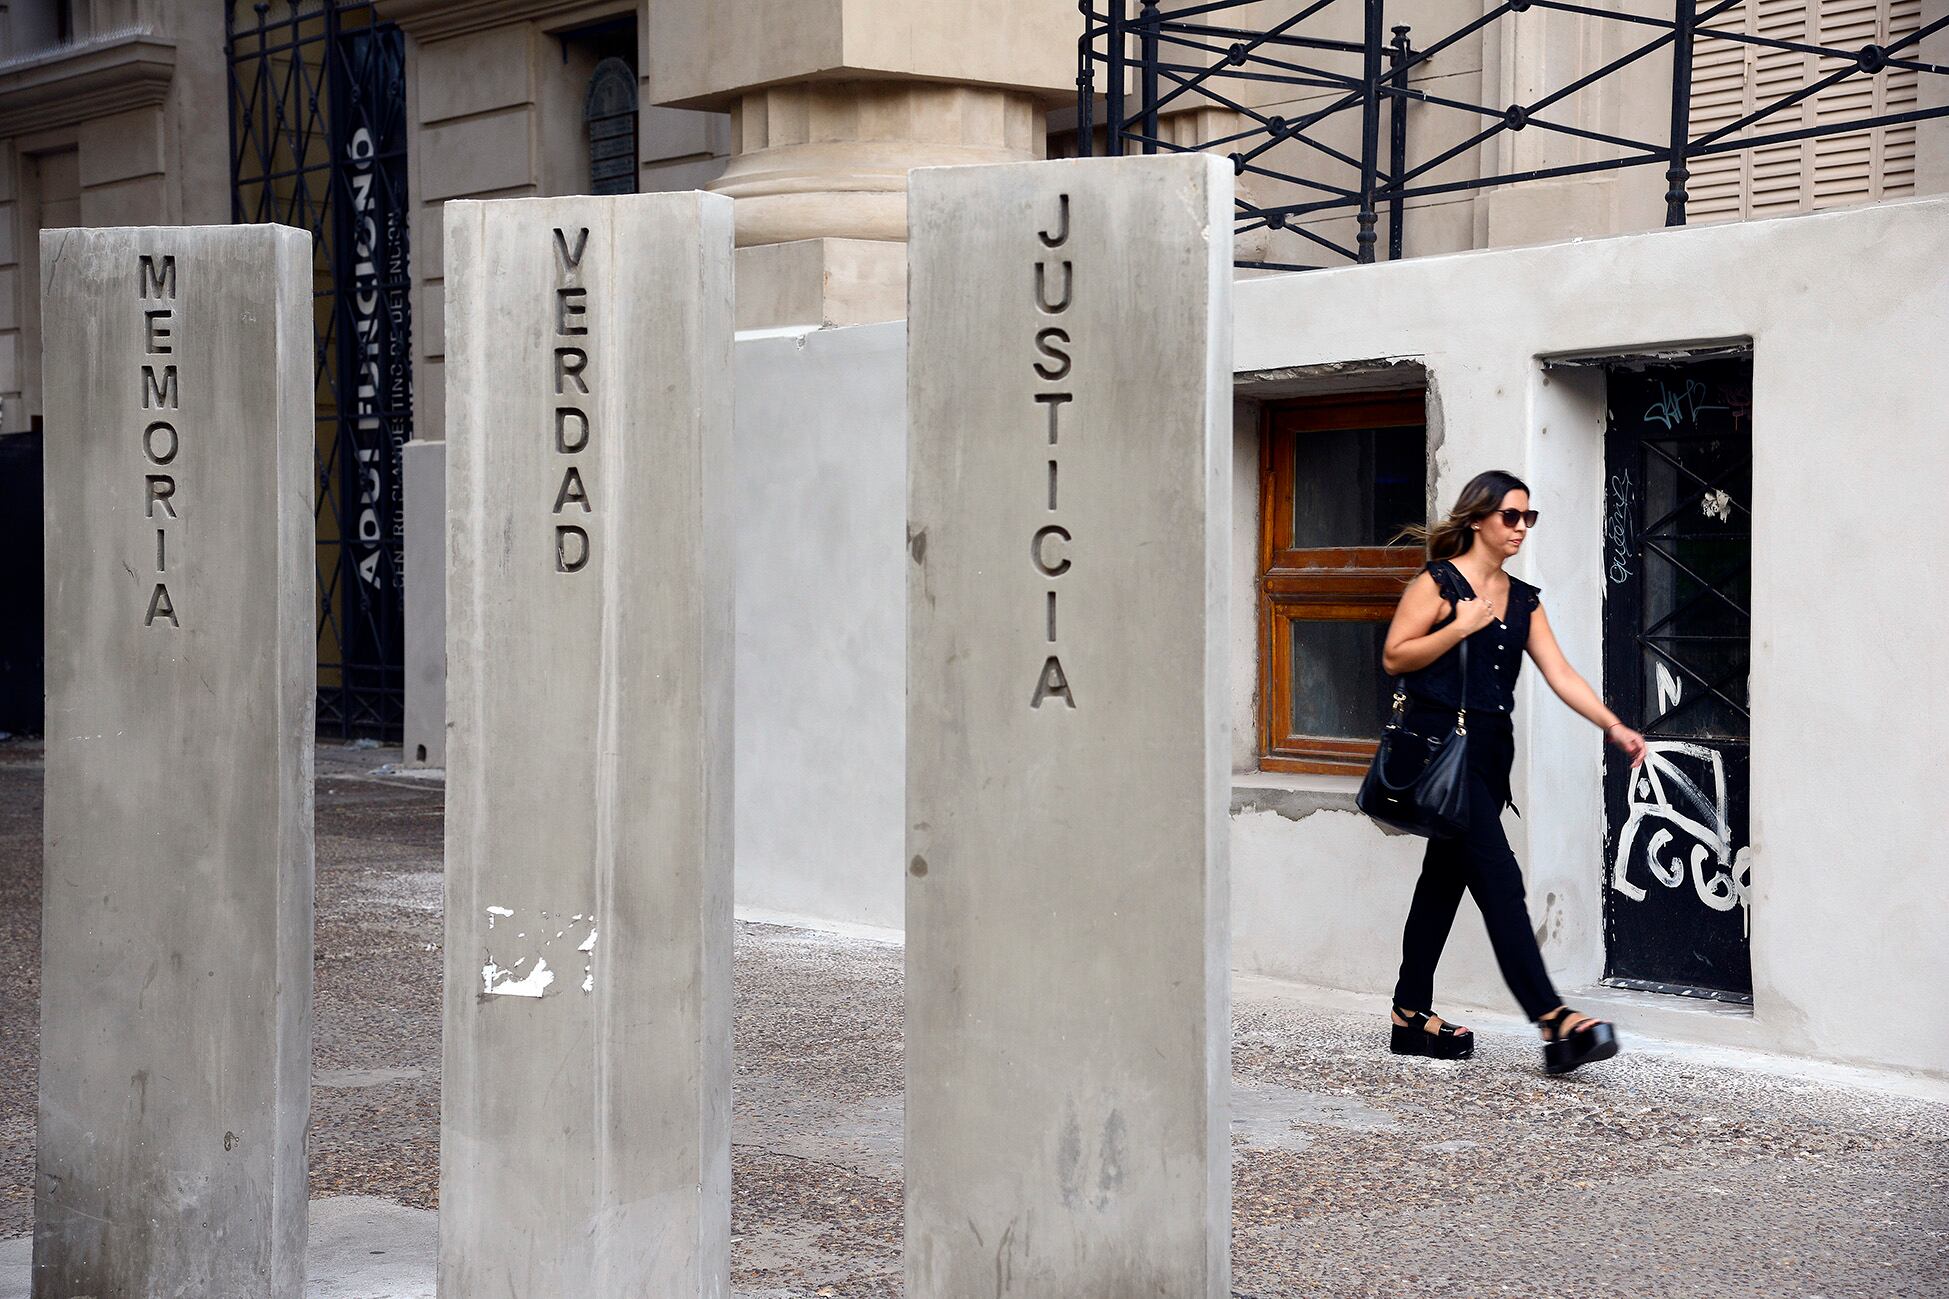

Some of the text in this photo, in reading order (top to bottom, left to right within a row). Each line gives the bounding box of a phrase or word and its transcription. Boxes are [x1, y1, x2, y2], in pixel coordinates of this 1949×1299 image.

[139, 254, 180, 628] MEMORIA
[346, 127, 381, 430] FUNCIONÓ
[552, 227, 592, 574] VERDAD
[1030, 193, 1077, 710] JUSTICIA
